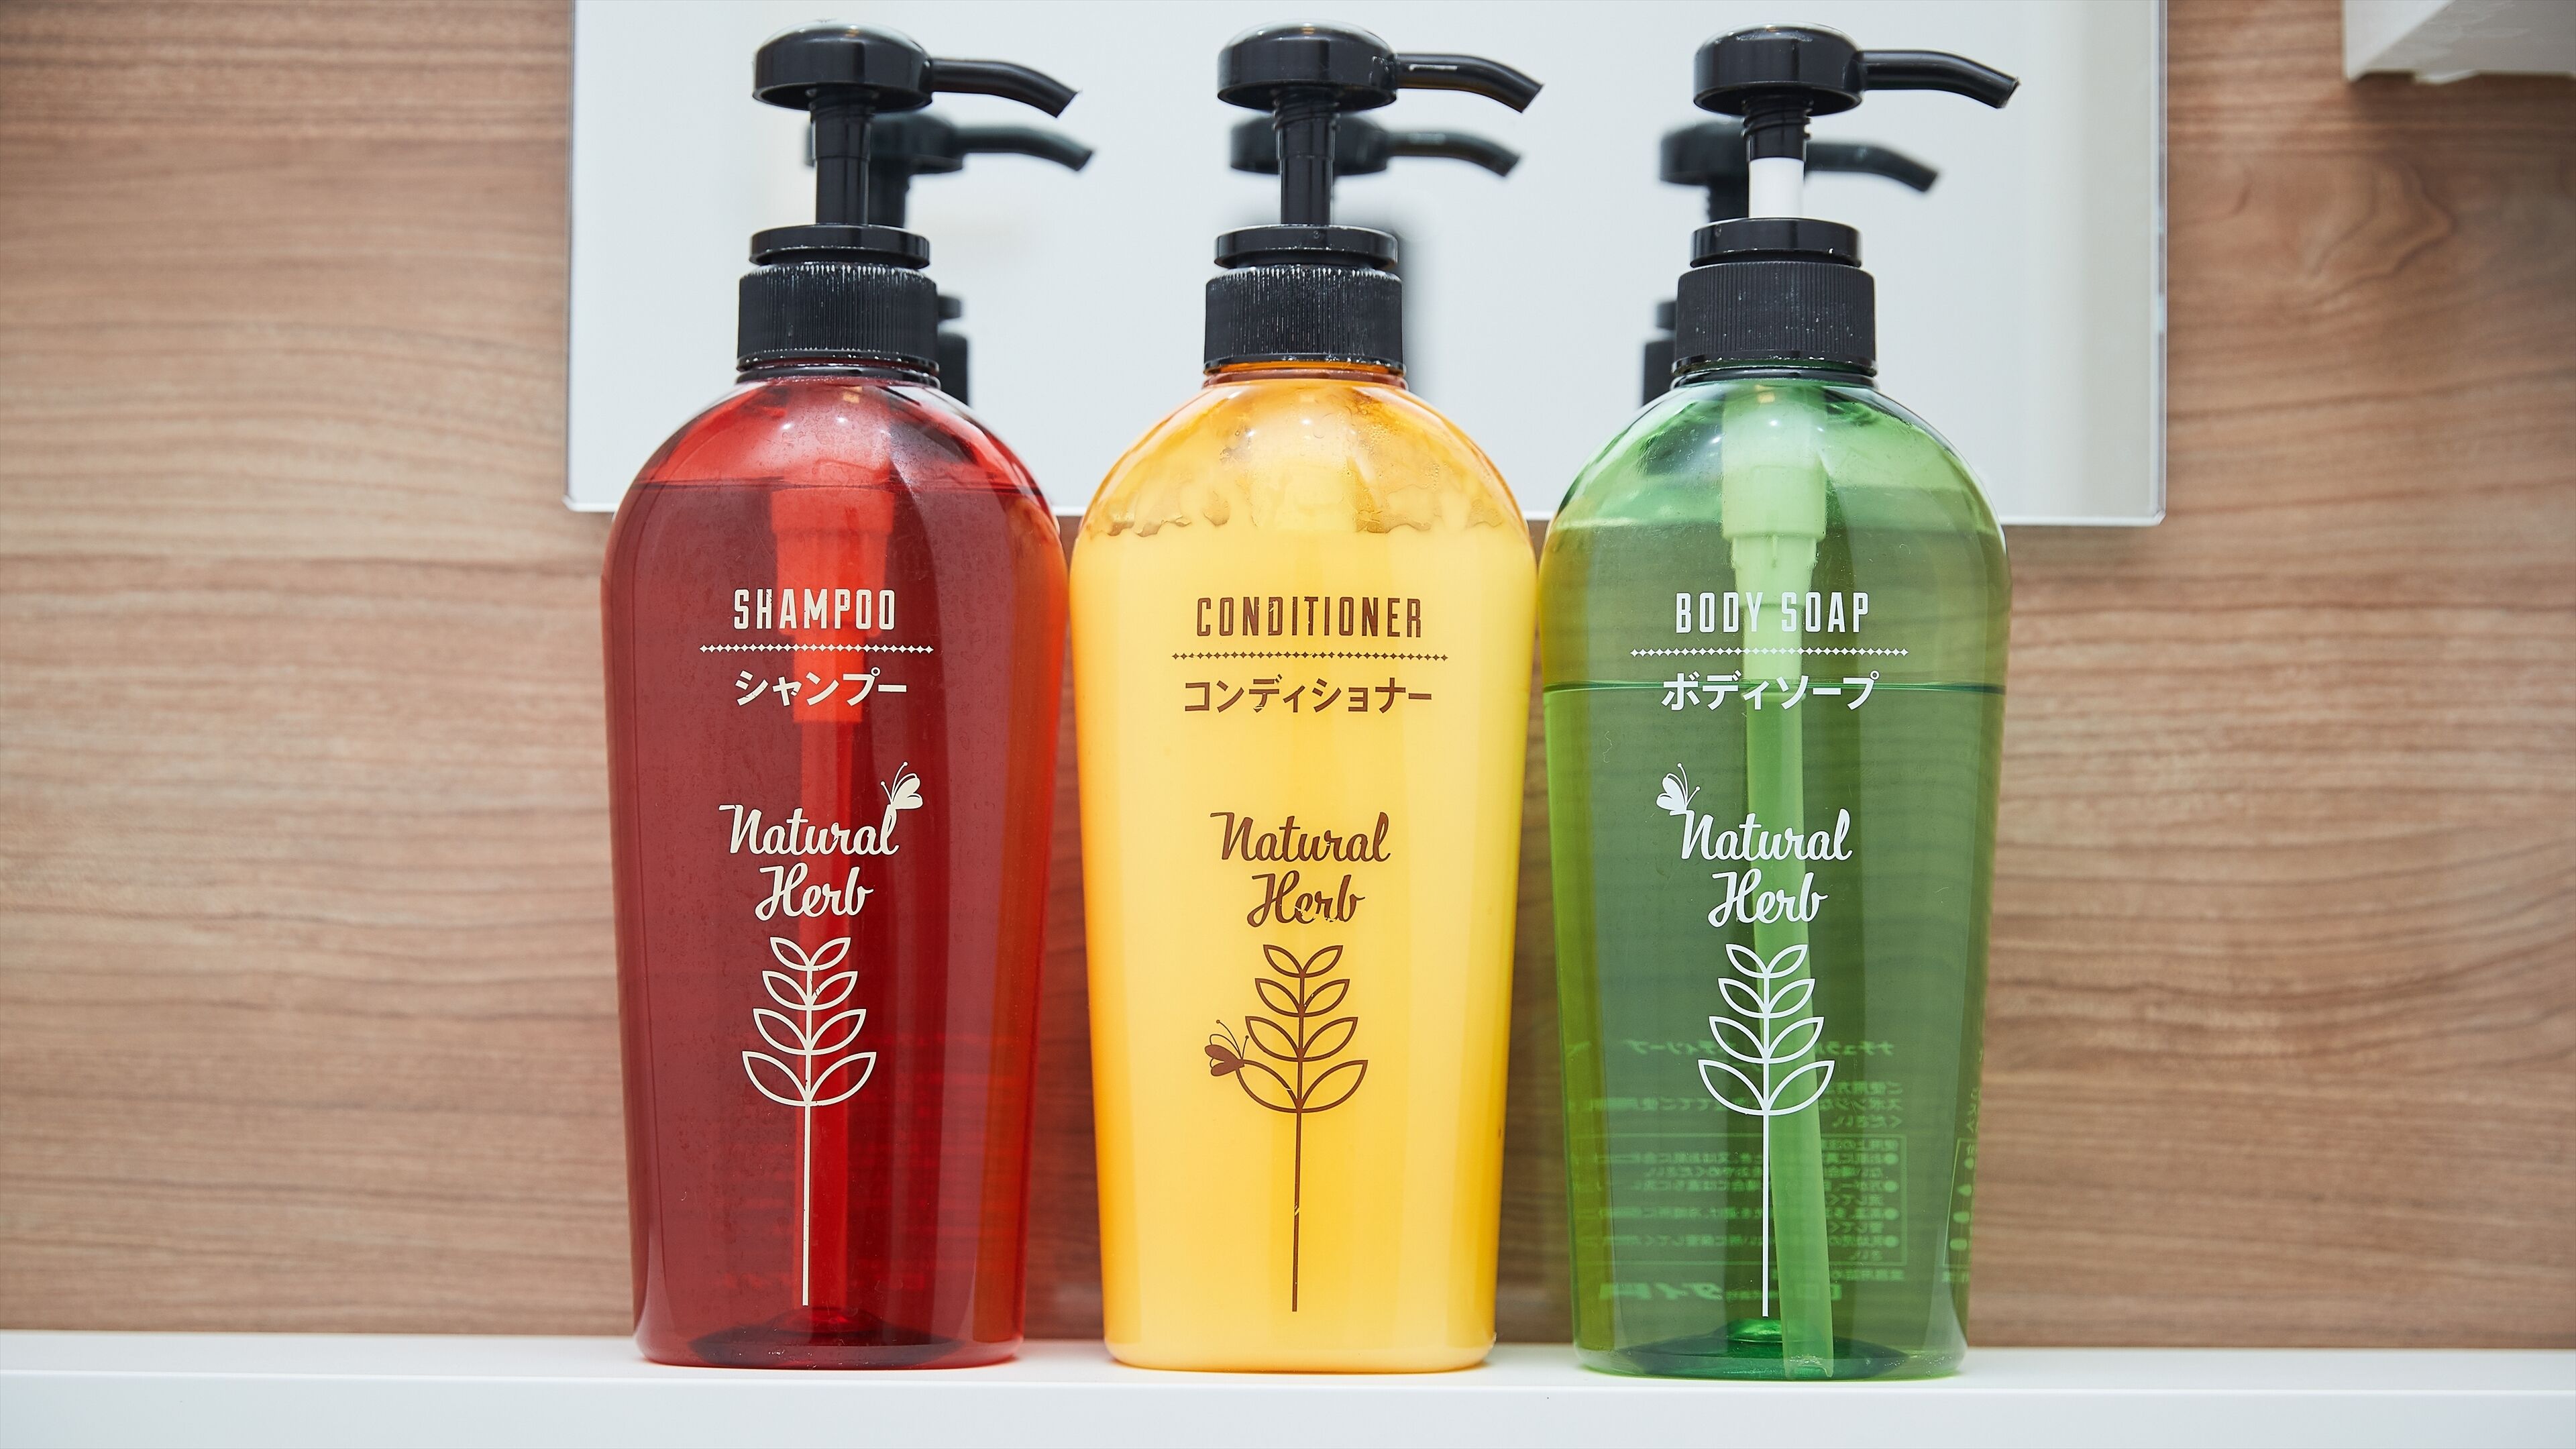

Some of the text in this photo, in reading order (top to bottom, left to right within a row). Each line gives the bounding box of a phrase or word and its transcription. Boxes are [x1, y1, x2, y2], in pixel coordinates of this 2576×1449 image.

[734, 588, 896, 630] SHAMPOO
[1196, 596, 1421, 638] CONDITIONER
[1676, 592, 1870, 633] BODY SOAP
[734, 666, 908, 707] シャンプー
[1184, 673, 1432, 714] コンディショナー
[1661, 669, 1880, 711] ボディソープ
[718, 804, 900, 856] Natural
[1210, 811, 1391, 863] Natural
[1668, 808, 1854, 861] Natural
[754, 862, 874, 922] Herb
[1246, 869, 1366, 928] Herb
[1707, 867, 1829, 928] Herb
